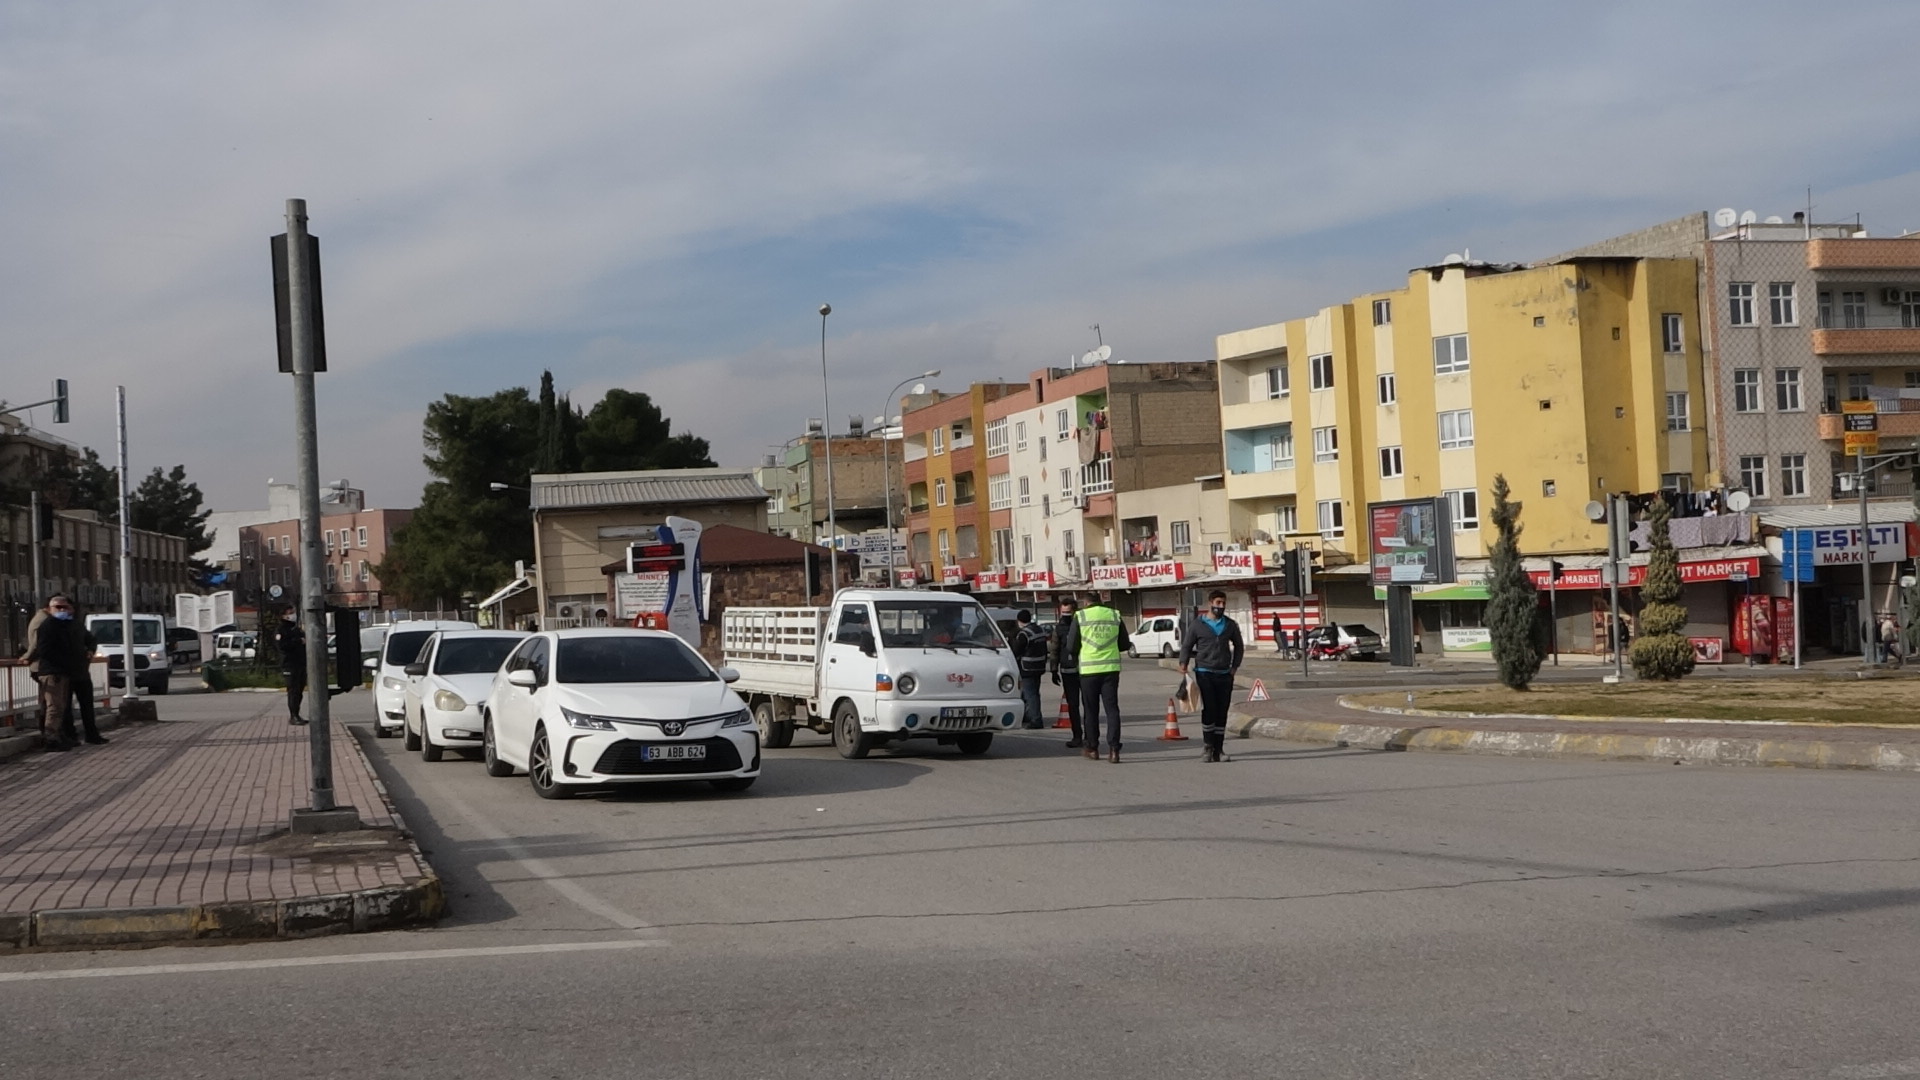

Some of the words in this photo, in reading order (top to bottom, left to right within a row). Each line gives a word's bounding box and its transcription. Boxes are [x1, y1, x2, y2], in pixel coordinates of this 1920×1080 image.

[1823, 551, 1877, 564] MARKT
[1093, 567, 1126, 580] ECZANE
[1137, 563, 1173, 578] ECZANE
[1696, 561, 1750, 577] MARKET
[1565, 574, 1600, 585] MARKET
[649, 747, 660, 758] 63
[667, 747, 684, 758] ABB
[687, 746, 705, 757] 624
